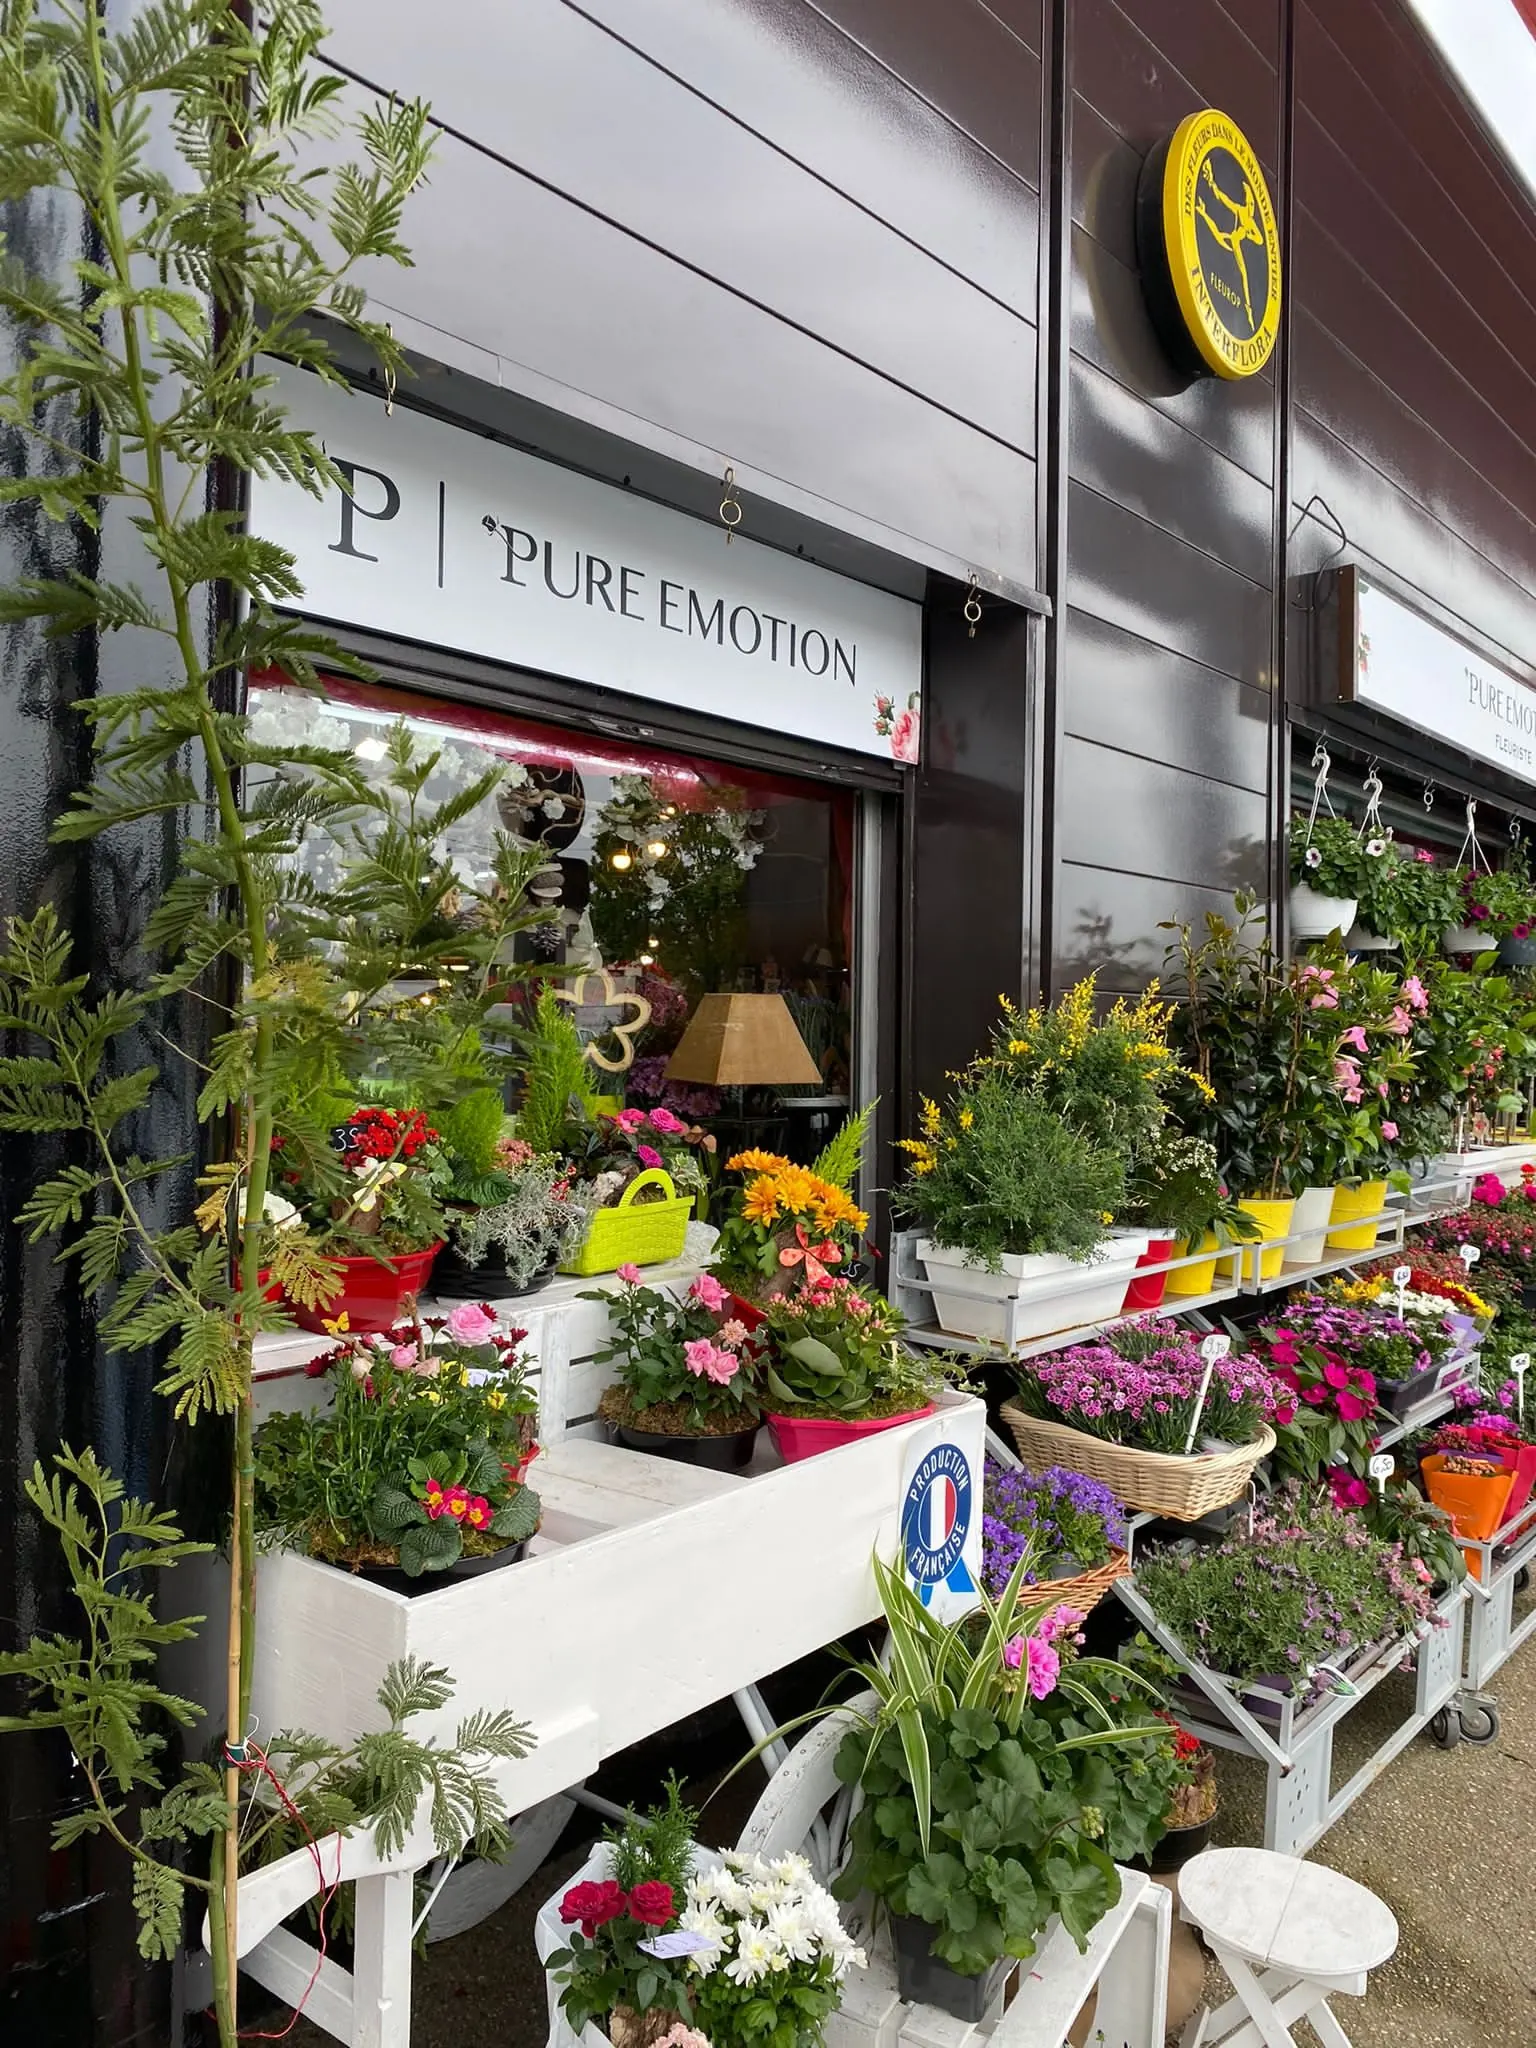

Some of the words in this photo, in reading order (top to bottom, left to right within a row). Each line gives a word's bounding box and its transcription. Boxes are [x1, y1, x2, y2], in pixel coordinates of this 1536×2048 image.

[1188, 127, 1212, 176] FLEURS
[1184, 176, 1193, 217] DES
[1245, 157, 1272, 225] MONDE
[1191, 266, 1273, 367] INTERFLORA
[1210, 271, 1241, 309] FLEUROP
[500, 524, 646, 622] PURE
[660, 579, 857, 688] EMOTION
[1469, 672, 1504, 719] PURE
[910, 1449, 969, 1502] PRODUCTION
[910, 1521, 966, 1577] FRANÇAISE
